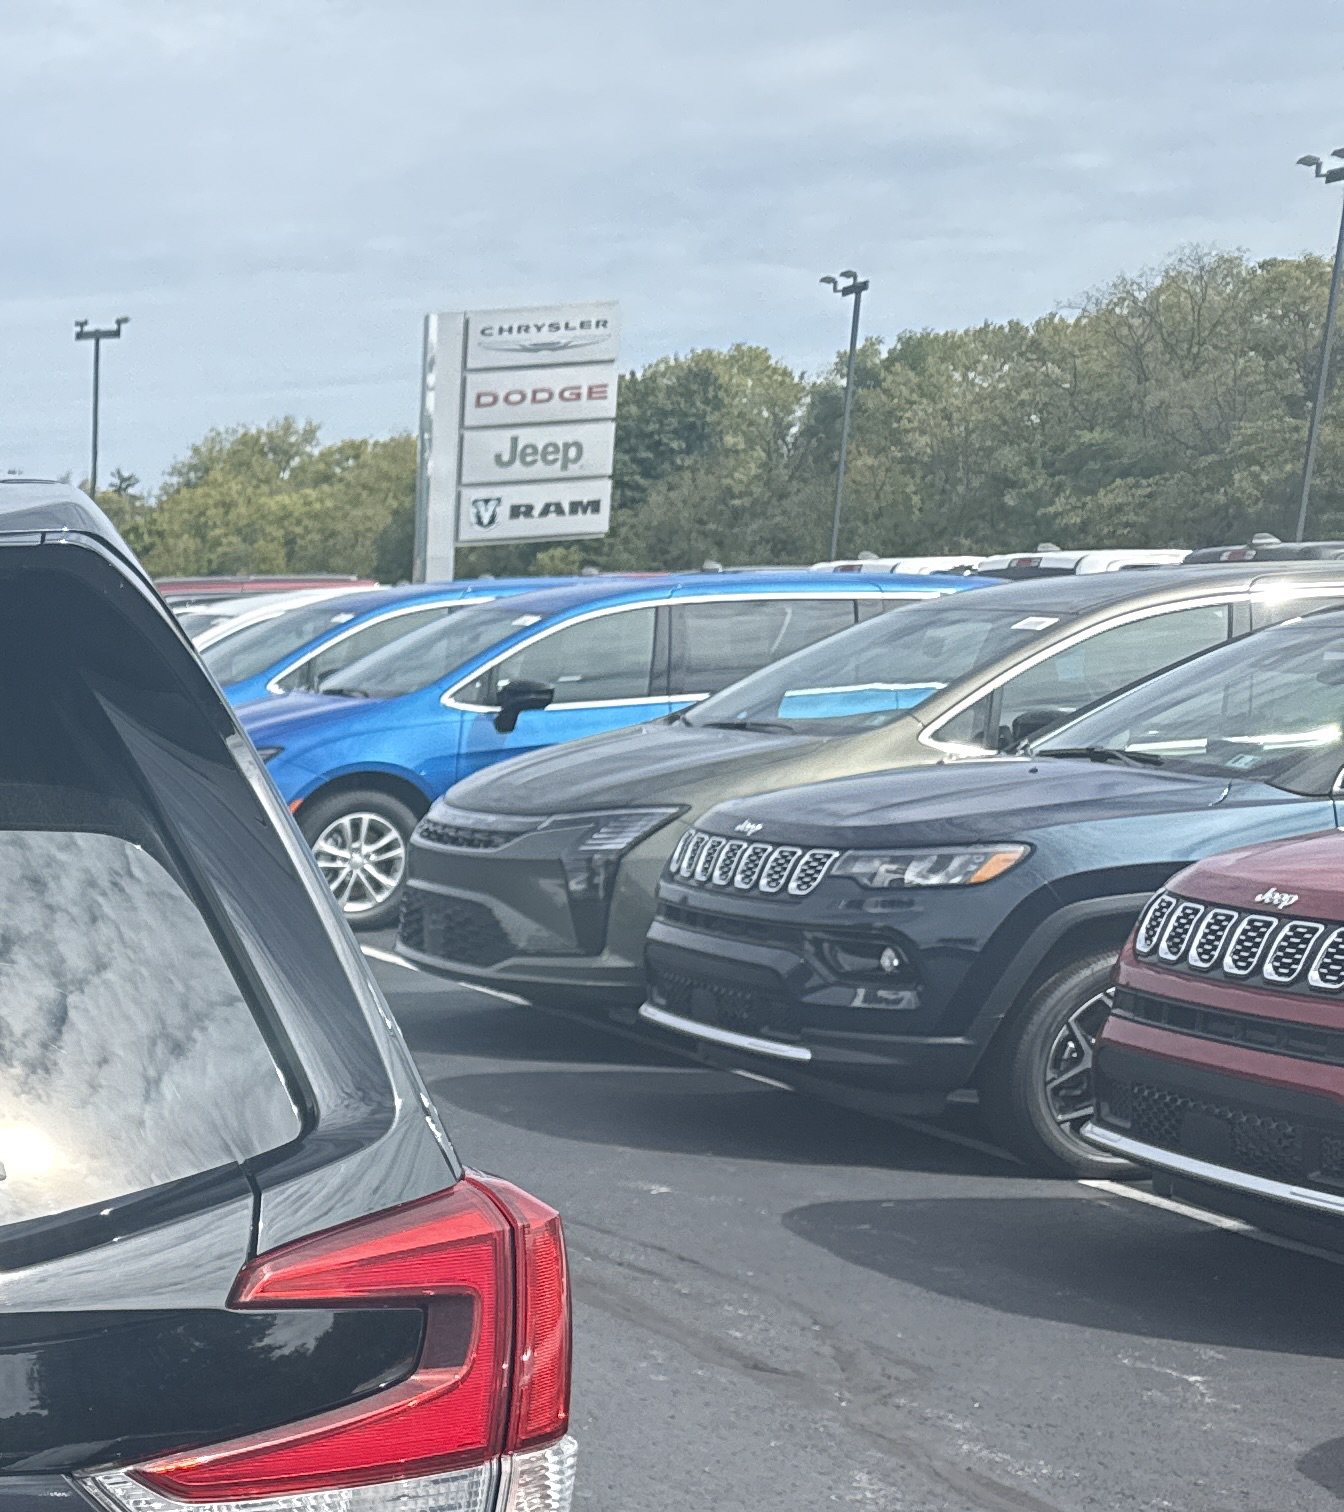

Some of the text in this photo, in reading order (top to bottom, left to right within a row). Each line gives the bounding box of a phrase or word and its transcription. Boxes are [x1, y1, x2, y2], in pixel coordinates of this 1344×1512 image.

[479, 319, 609, 337] CHRYSLER
[474, 383, 610, 409] DODGE
[493, 436, 584, 471] Jeep
[508, 498, 602, 521] RAM
[1254, 887, 1299, 910] Jeep
